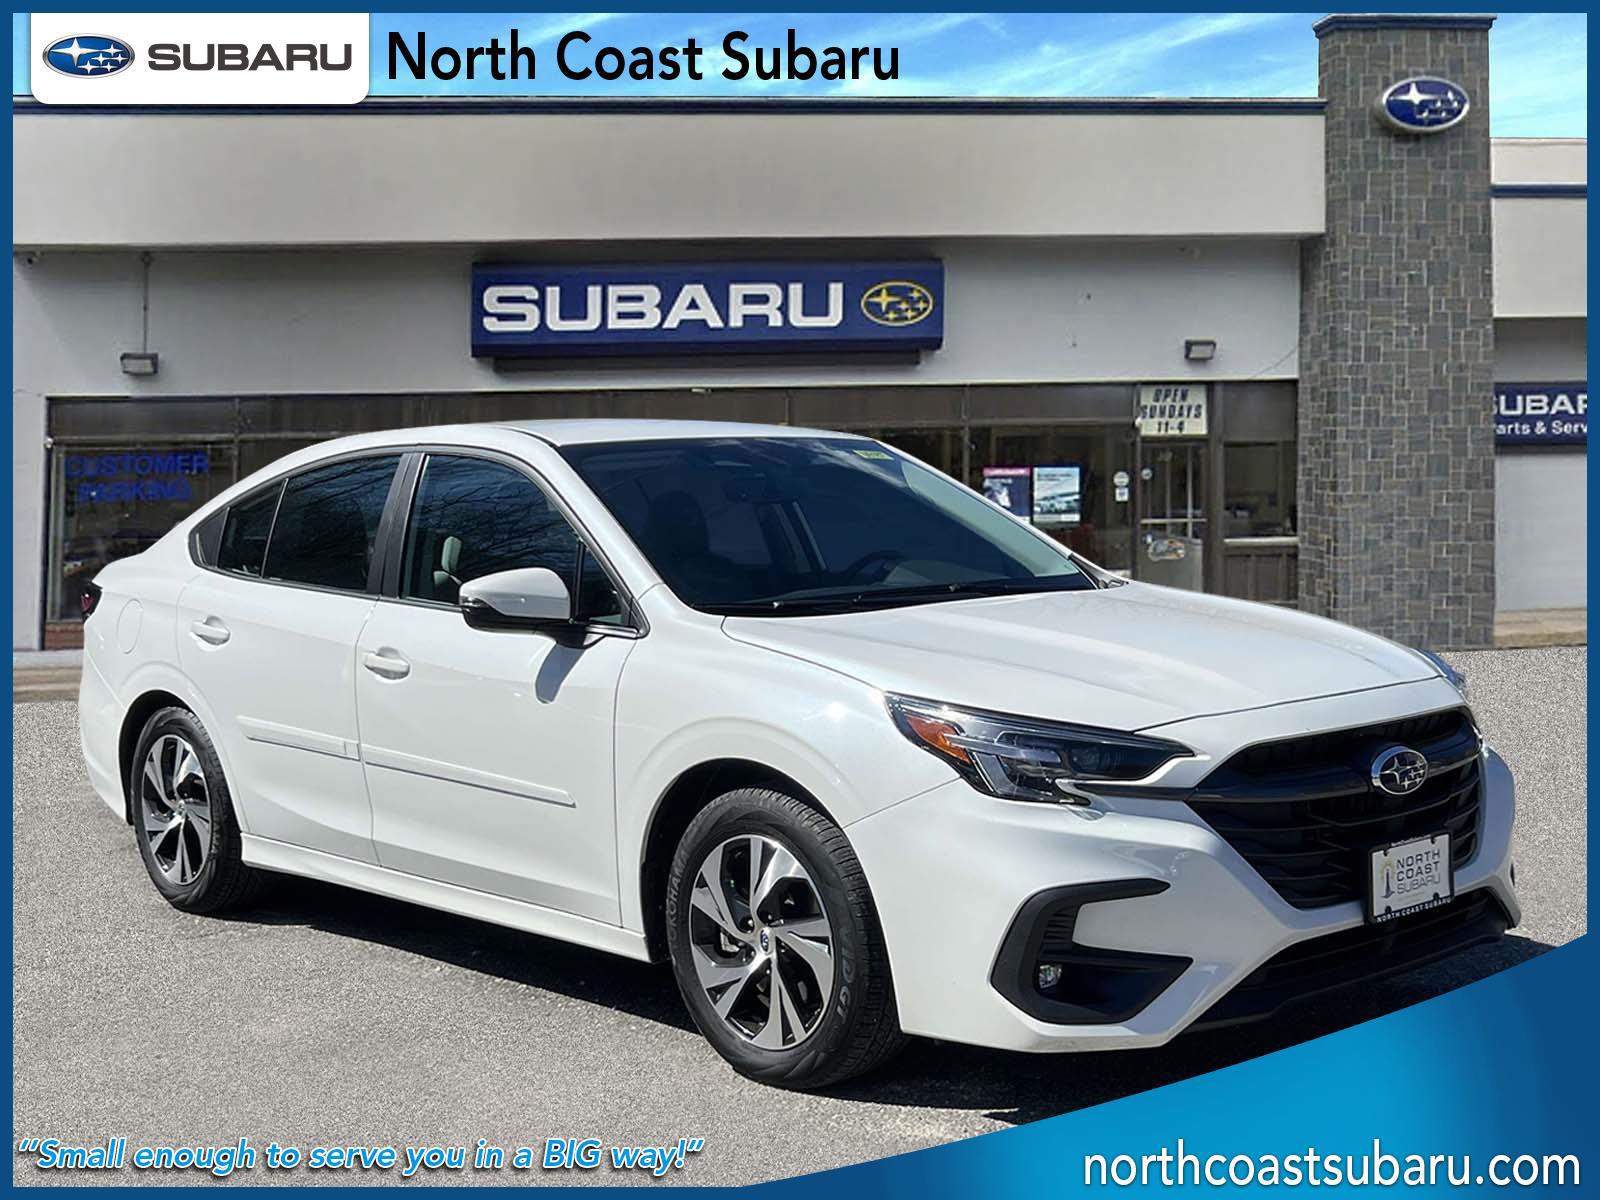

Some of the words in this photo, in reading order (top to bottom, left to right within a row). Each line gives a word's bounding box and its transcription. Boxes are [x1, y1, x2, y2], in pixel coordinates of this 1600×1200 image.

[482, 282, 843, 332] SUBARU
[1152, 388, 1190, 403] OPEN
[1139, 404, 1202, 419] SUNDAYS
[1495, 422, 1531, 436] arts
[1534, 420, 1546, 435] &
[65, 453, 209, 477] CUSTOMER
[78, 480, 192, 503] PARKING
[1396, 849, 1441, 868] NORTH
[1396, 861, 1440, 882] COAST
[1396, 874, 1441, 895] SUBARU
[1376, 911, 1401, 923] NORTH
[1401, 905, 1423, 917] COAST
[1424, 897, 1452, 910] SUBARU
